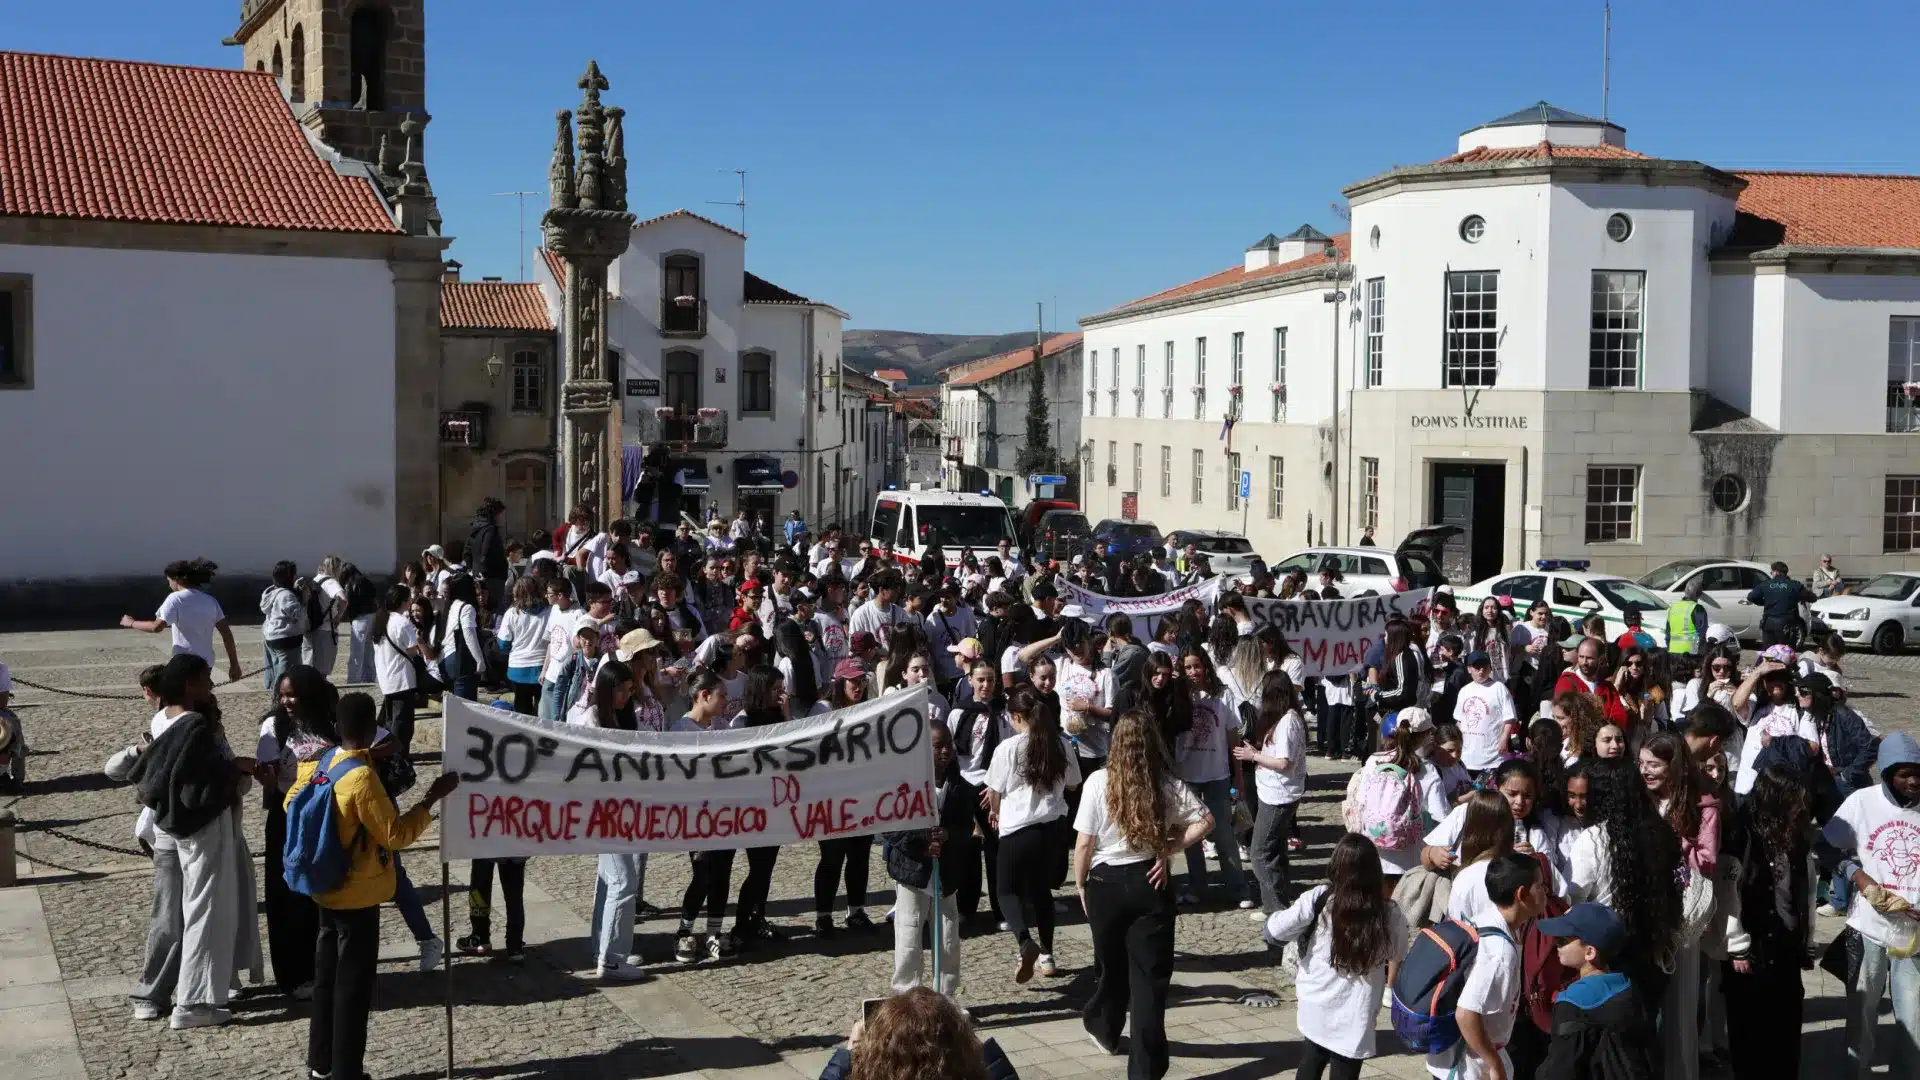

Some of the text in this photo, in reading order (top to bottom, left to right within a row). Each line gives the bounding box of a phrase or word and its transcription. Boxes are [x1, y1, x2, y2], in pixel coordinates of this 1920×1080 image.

[1411, 415, 1528, 429] DOMVS IVSTITIAE
[563, 707, 923, 783] ANIVERSÁRIO
[468, 793, 582, 843] PARQUE
[585, 797, 767, 842] ARQUEOLÓGICO
[771, 774, 801, 808] DO
[789, 798, 859, 841] VALE
[876, 780, 935, 822] CÔA!
